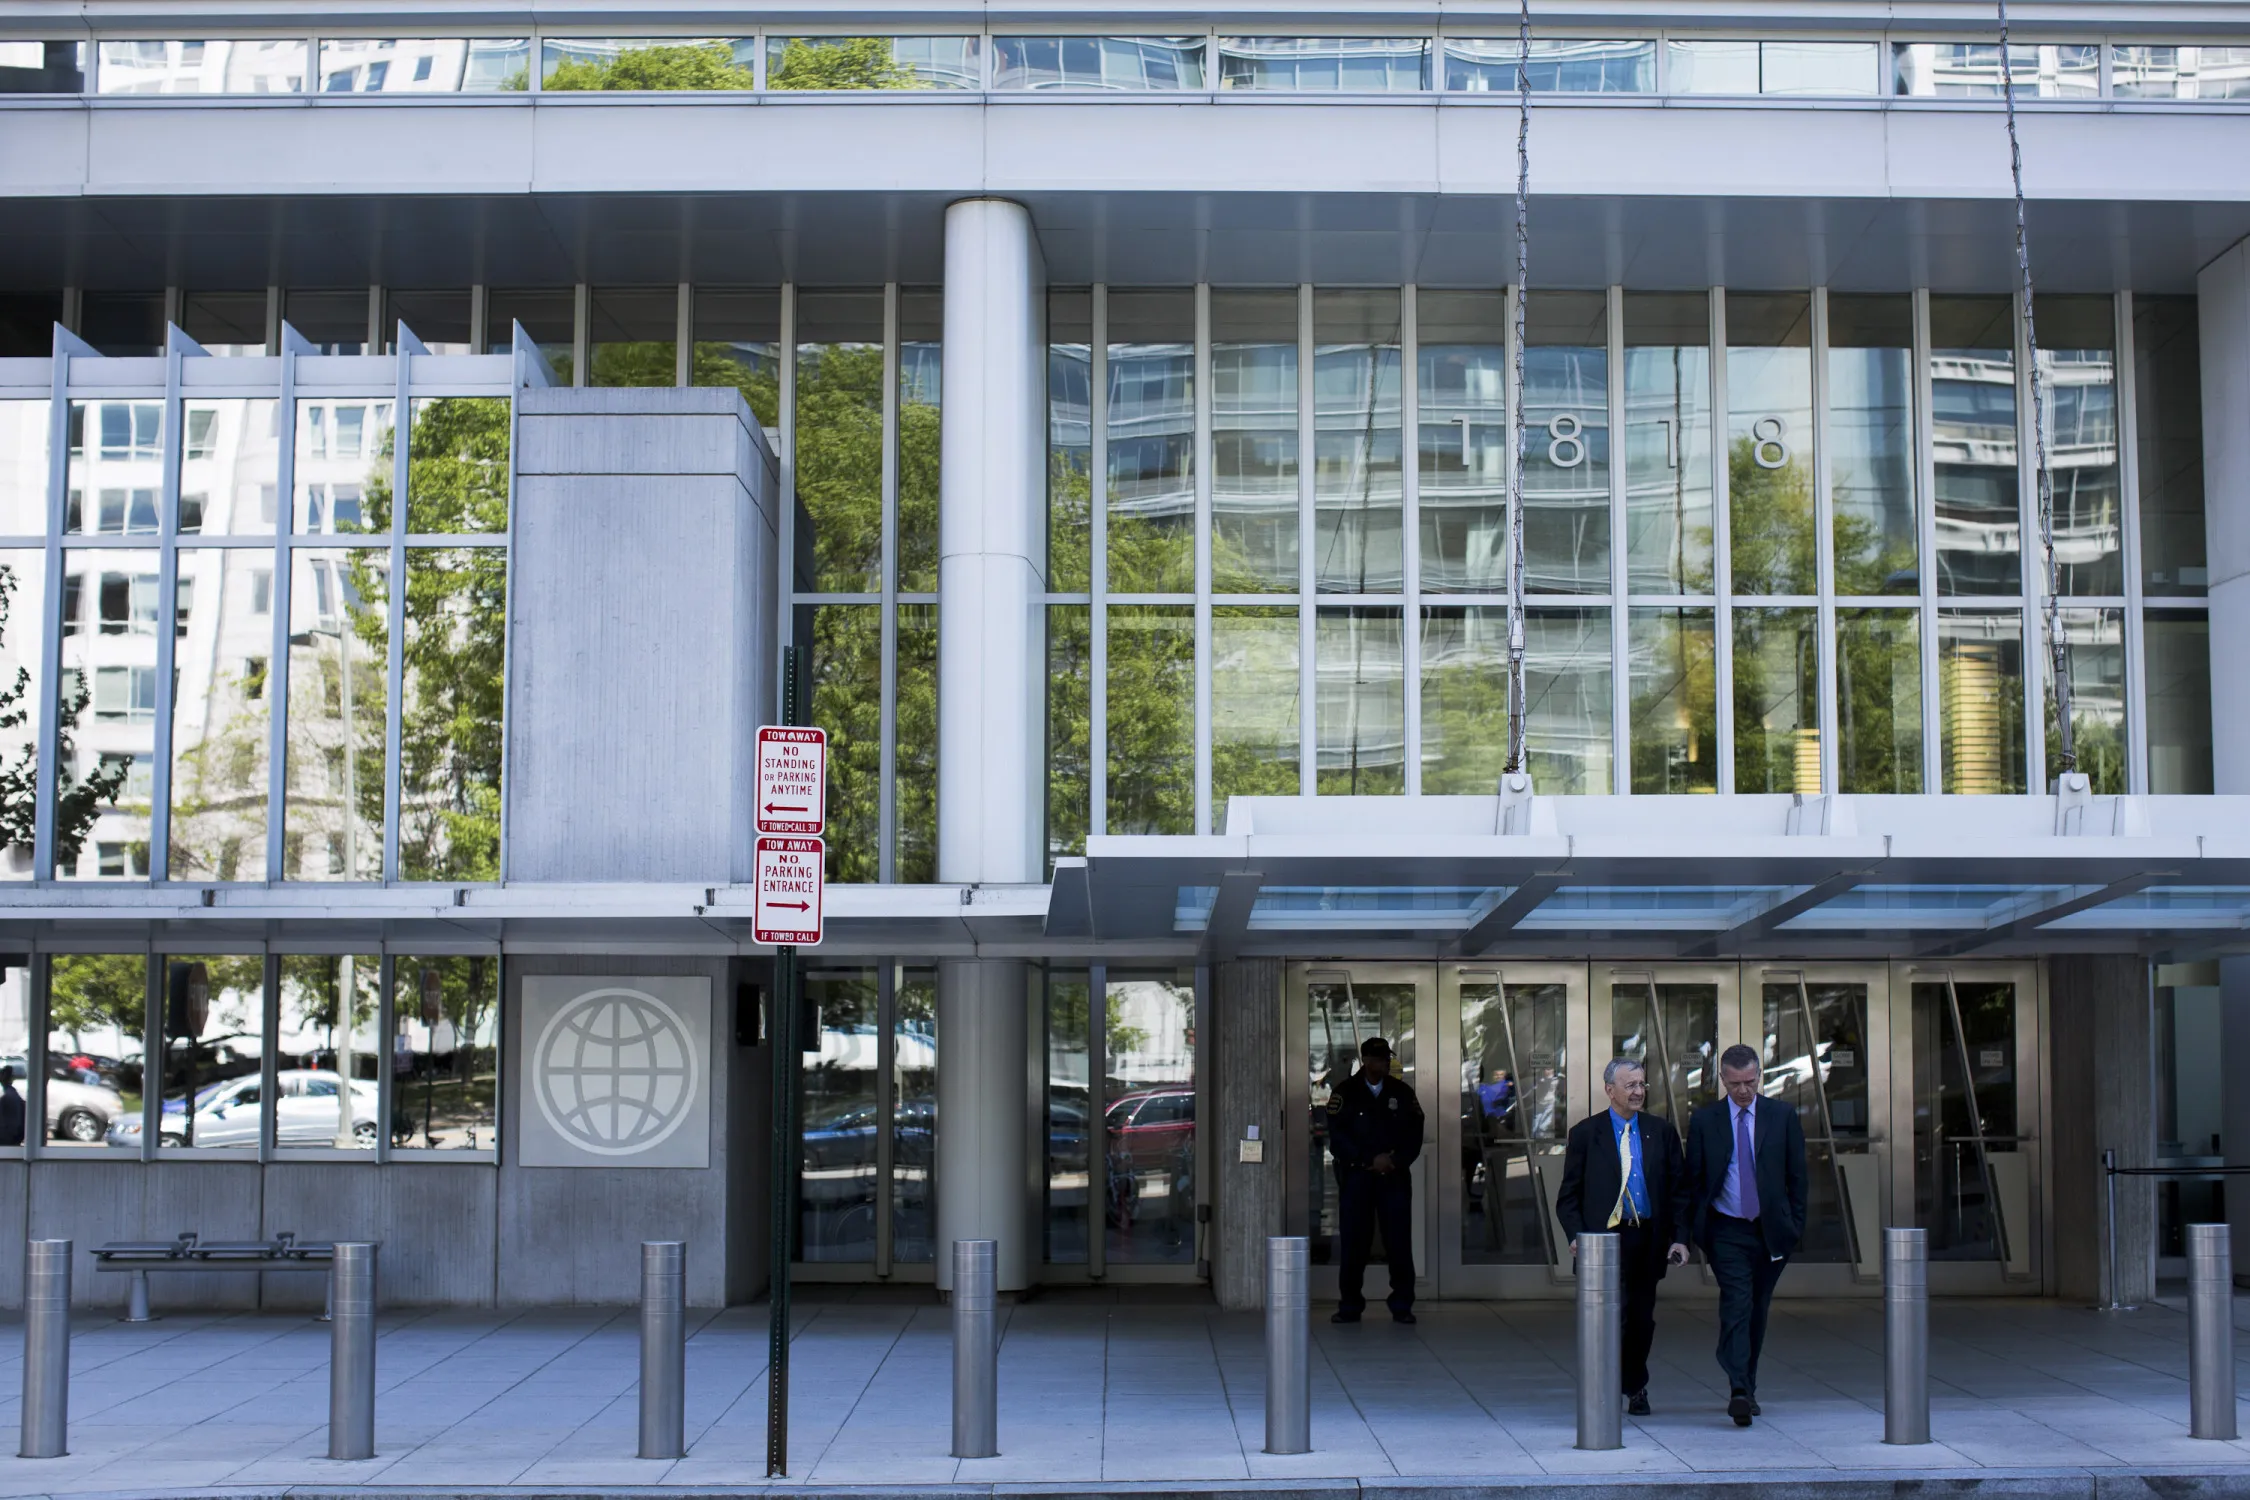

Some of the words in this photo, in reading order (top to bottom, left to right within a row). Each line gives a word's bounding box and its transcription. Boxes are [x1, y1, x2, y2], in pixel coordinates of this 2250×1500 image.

[767, 731, 786, 740] TOW
[787, 732, 817, 741] AWAY
[783, 746, 799, 756] NO
[765, 758, 815, 770] STANDING
[764, 773, 775, 781] OR
[777, 772, 816, 783] PARKING
[771, 784, 813, 796] ANYTIME
[761, 821, 768, 831] IF
[808, 823, 817, 832] 311
[765, 840, 784, 850] TOW
[787, 841, 813, 851] AWAY
[779, 854, 799, 864] NO
[765, 865, 812, 878] PARKING
[763, 880, 814, 893] ENTRANCE
[761, 932, 769, 940] IF
[771, 932, 794, 941] TOWED
[797, 933, 815, 942] CALL
